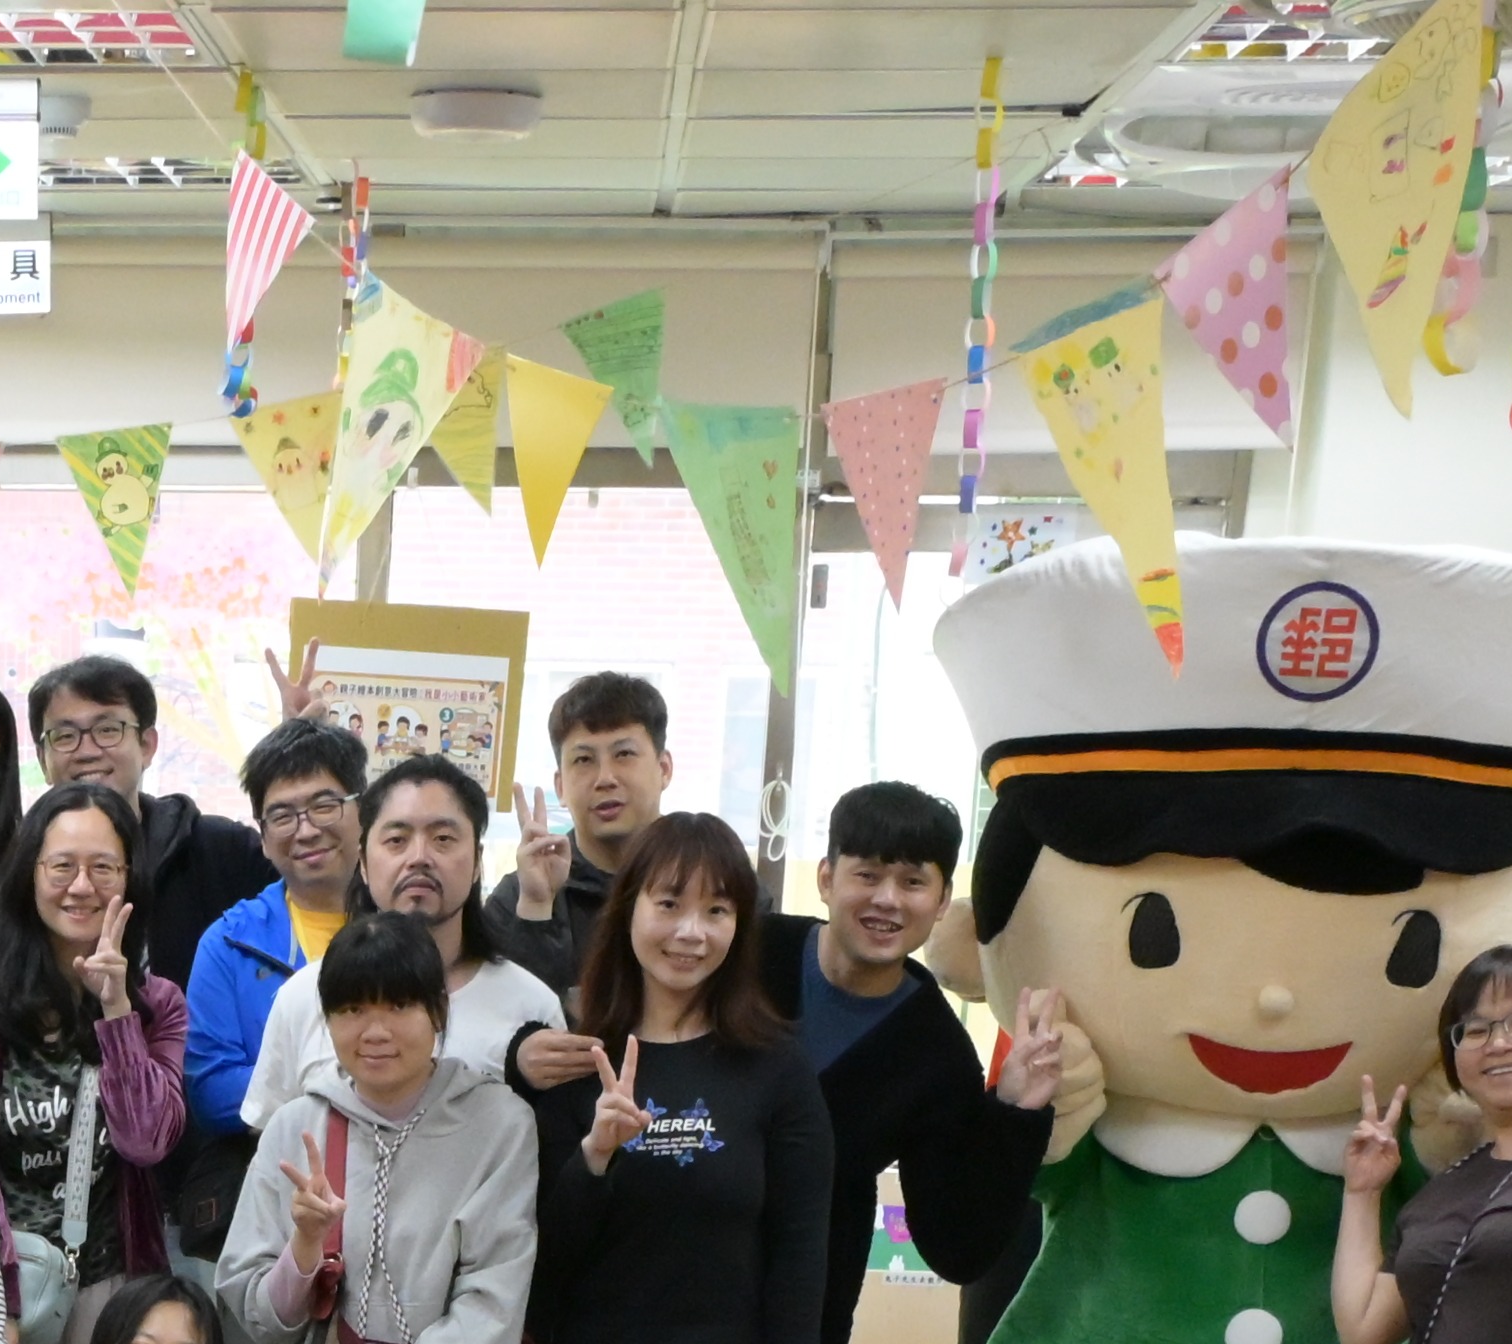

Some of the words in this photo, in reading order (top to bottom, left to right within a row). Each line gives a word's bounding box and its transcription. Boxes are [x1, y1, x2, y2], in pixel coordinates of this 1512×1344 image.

[1279, 606, 1359, 678] 郵
[4, 1085, 71, 1137] High
[647, 1117, 716, 1134] HEREAL
